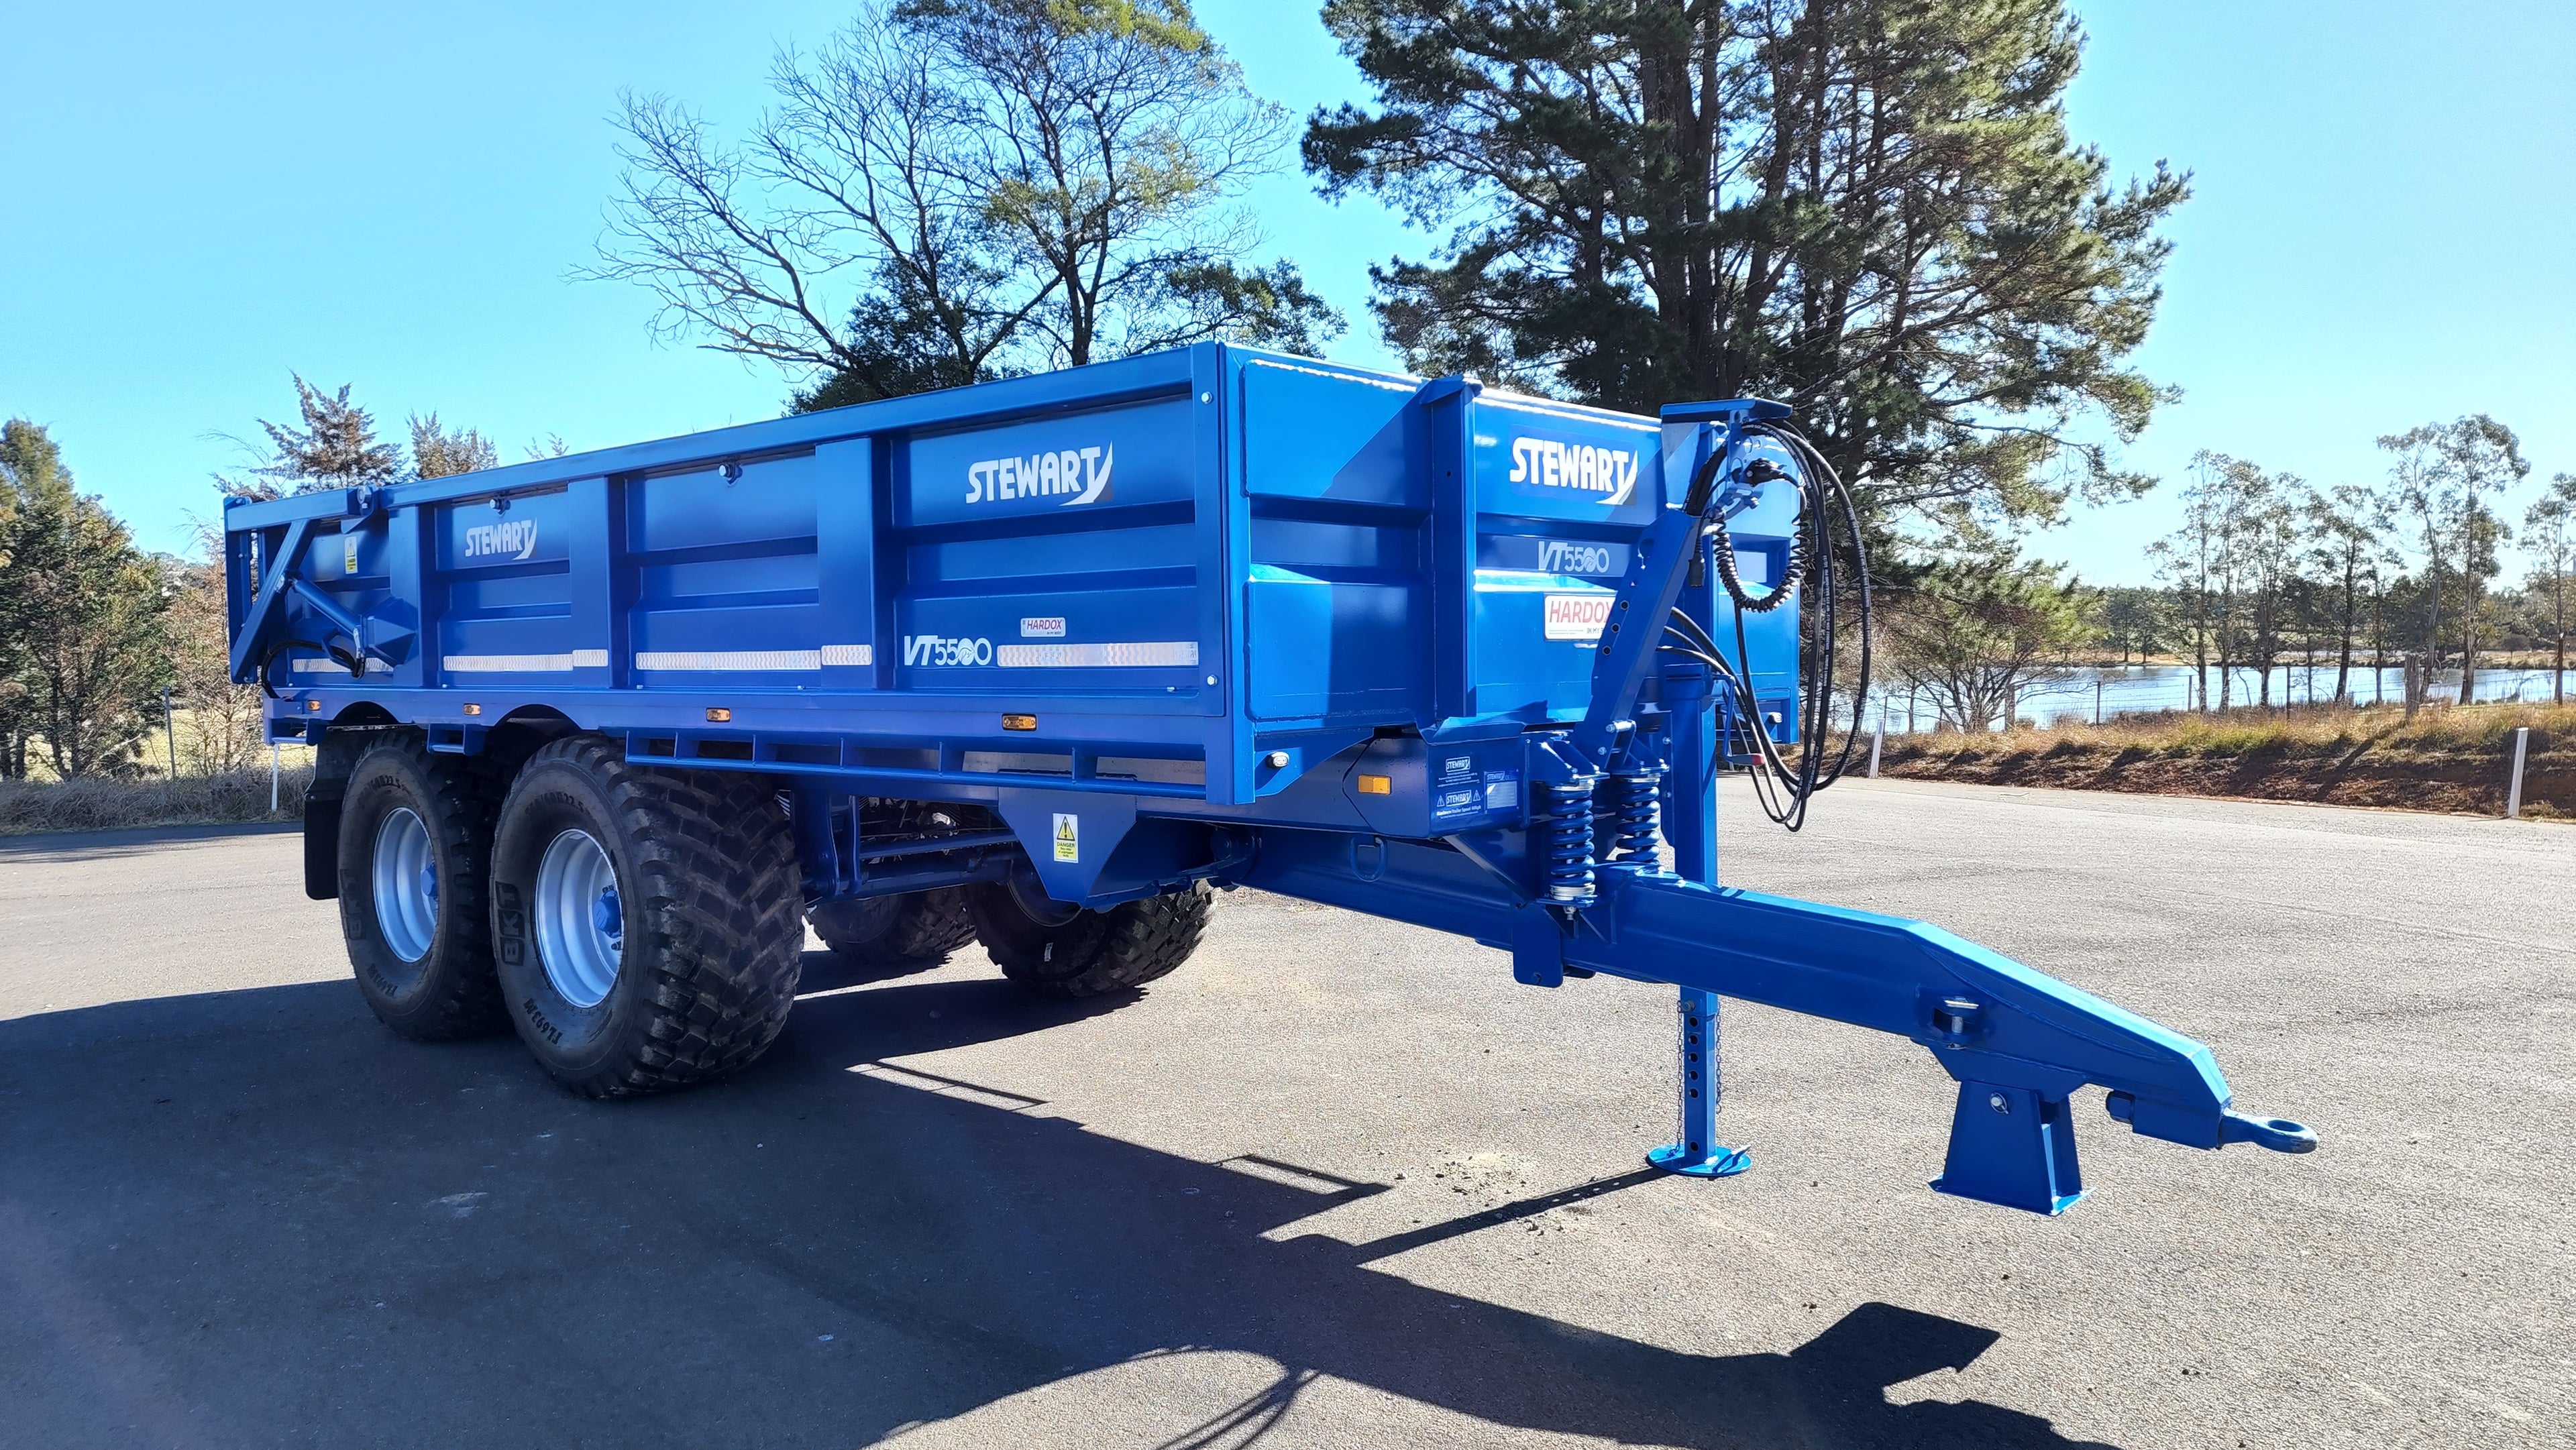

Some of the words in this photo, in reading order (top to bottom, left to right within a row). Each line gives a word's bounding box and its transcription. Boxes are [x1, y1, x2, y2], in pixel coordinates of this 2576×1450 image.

[965, 441, 1112, 506] STEWART
[1509, 436, 1638, 505] STEWART
[465, 517, 537, 561] STEWART
[1538, 541, 1609, 573] VT5500
[1027, 620, 1062, 630] HARDOX
[904, 635, 991, 665] VT5500
[1447, 759, 1469, 770] STEWART
[1447, 793, 1470, 803] STEWART
[497, 883, 521, 963] BKT
